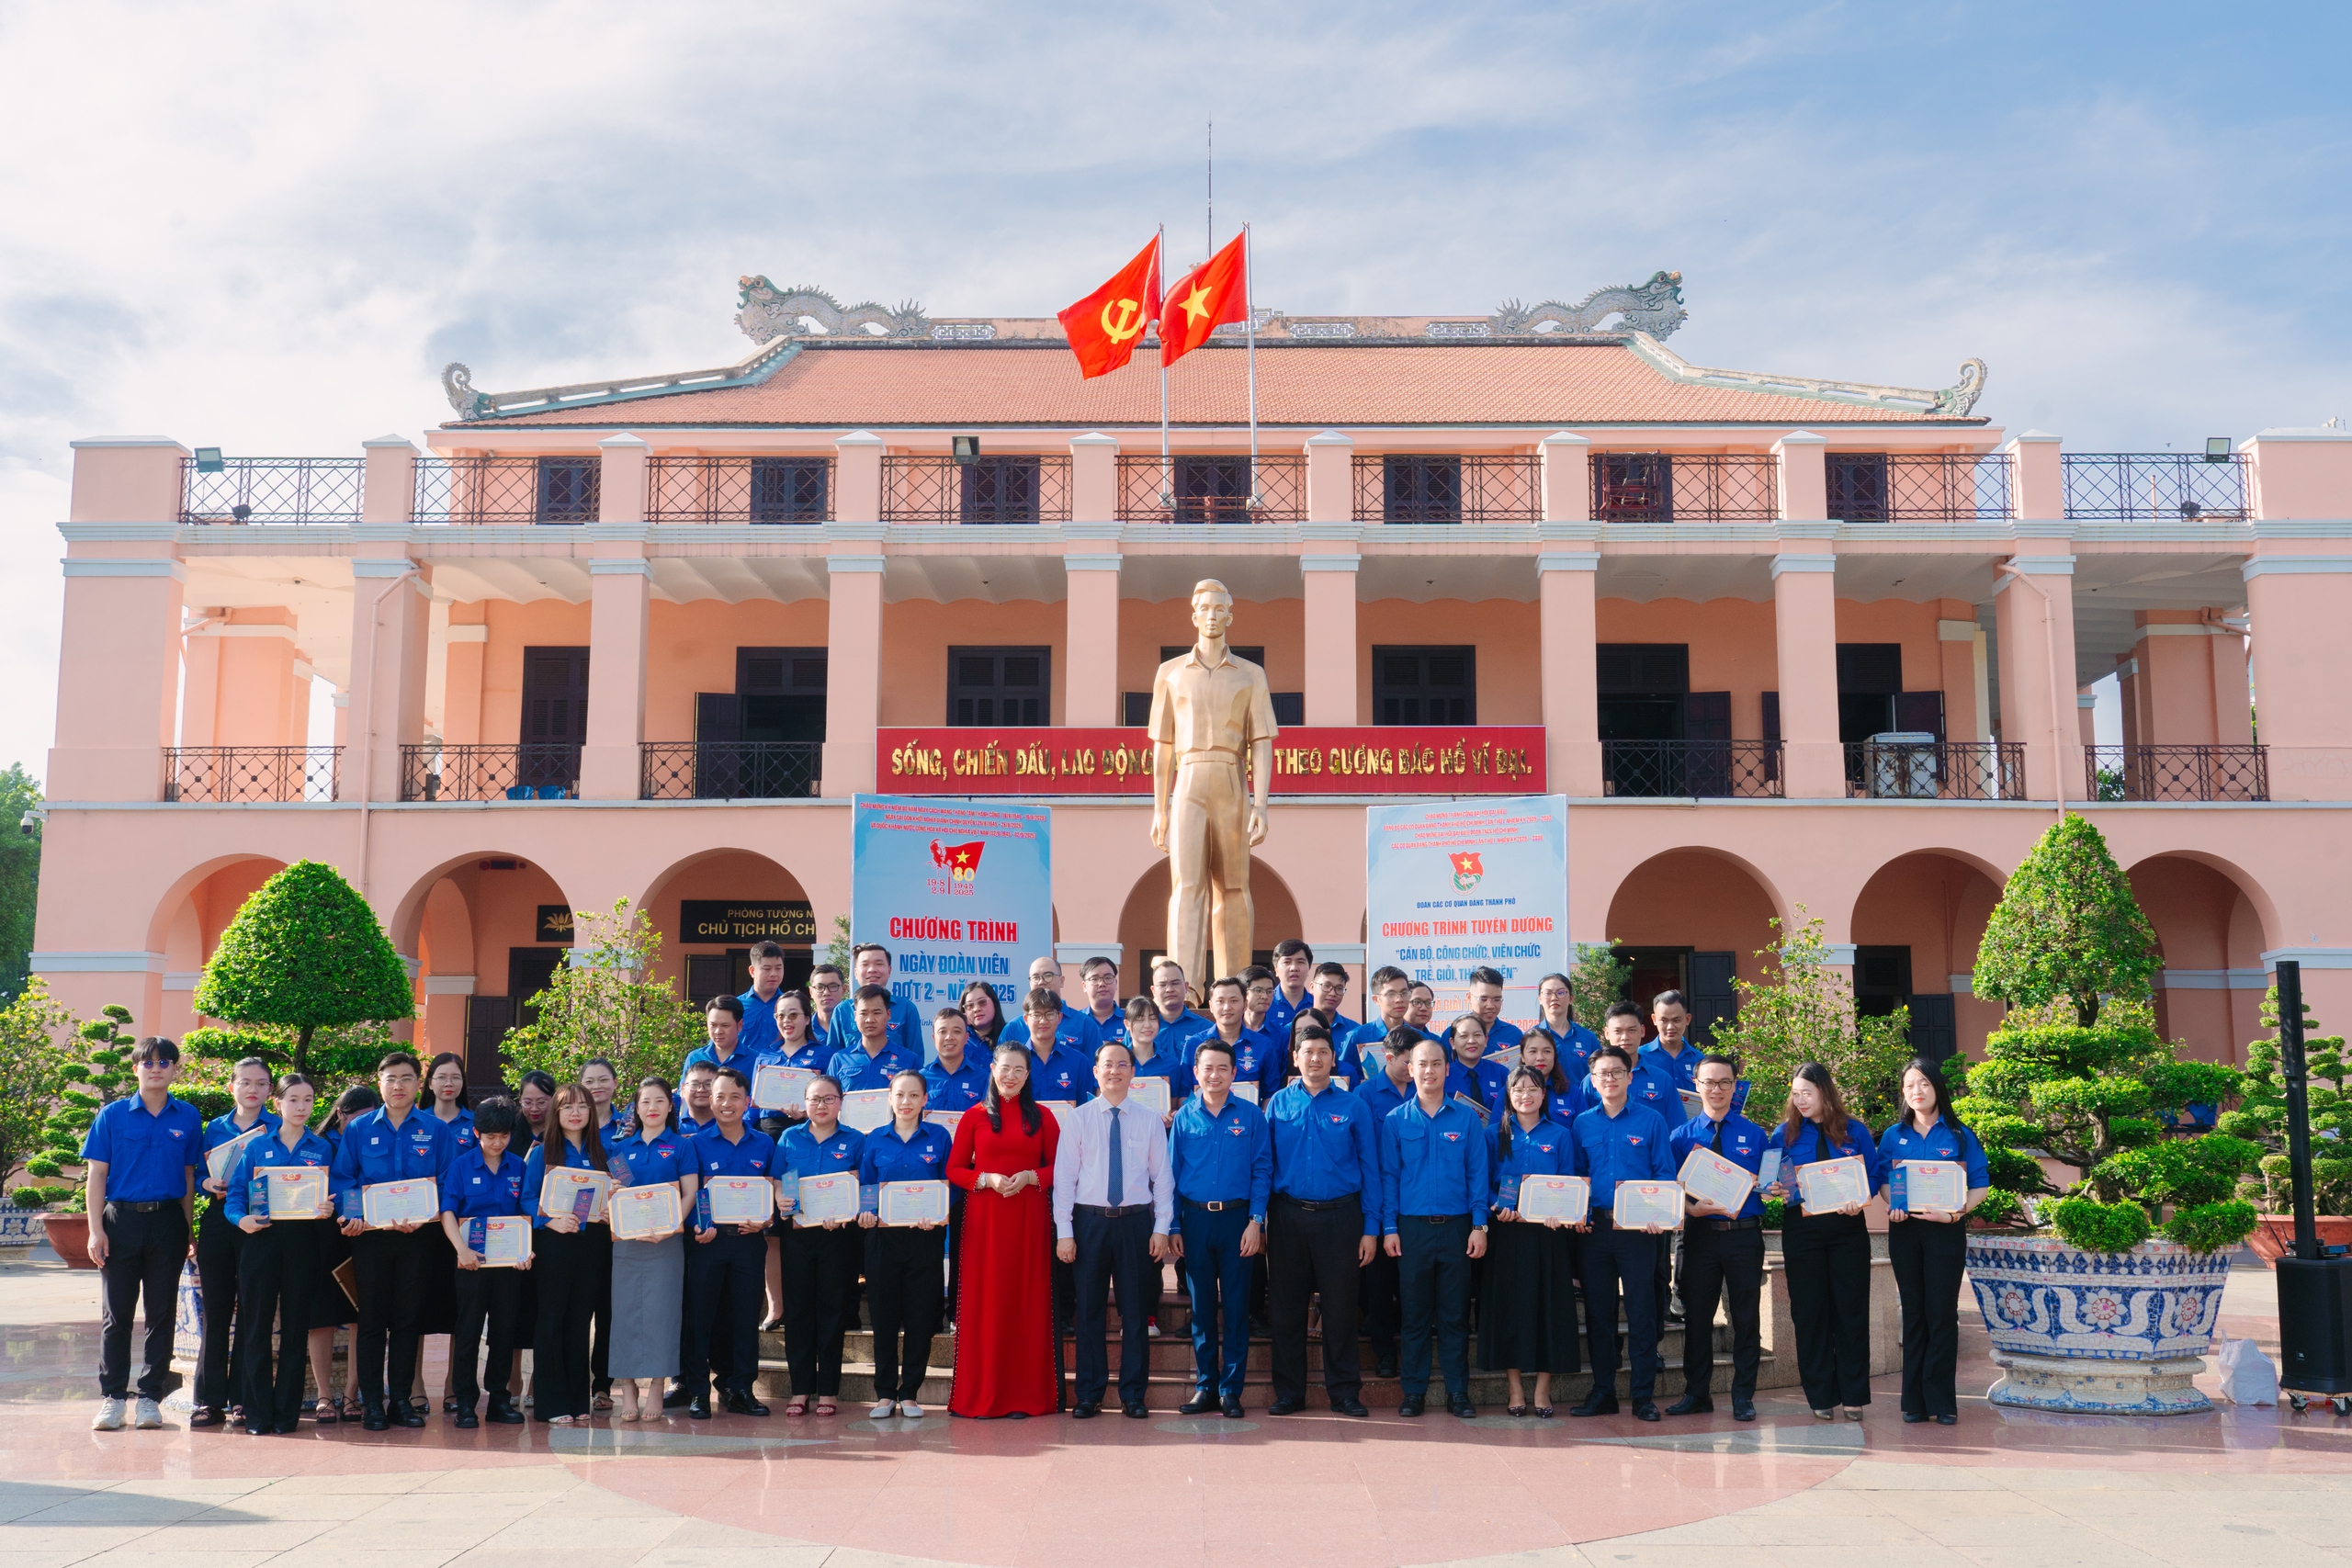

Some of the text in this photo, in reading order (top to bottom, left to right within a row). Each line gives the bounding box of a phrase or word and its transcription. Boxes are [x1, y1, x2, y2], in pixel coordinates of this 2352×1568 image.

[891, 739, 947, 782] SỐNG,
[954, 740, 1009, 775] CHIẾN
[1015, 740, 1057, 781] ĐẤU,
[1061, 749, 1096, 775] LAO
[1102, 742, 1153, 783] ĐỘNG
[1274, 748, 1323, 775] THEO
[1329, 743, 1393, 775] GƯƠNG
[1399, 742, 1435, 775] BÁC
[1441, 738, 1467, 775] HỒ
[1471, 741, 1491, 775] VĨ
[1496, 748, 1532, 782] ĐẠI.
[927, 879, 945, 887] 19-8
[953, 867, 975, 882] 80
[931, 886, 945, 895] 2-9
[1417, 896, 1516, 909] ĐOÀN CÁC CƠ QUAN ĐẢNG THÀNH PHỐ
[728, 907, 763, 919] PHÒNG
[697, 919, 815, 938] CHỦ TỊCH HỒ CH
[889, 916, 1019, 943] CHƯƠNG TRÌNH
[1382, 915, 1554, 938] CHƯƠNG TRÌNH TUYÊN DƯƠNG
[1419, 945, 1435, 964] BỘ,
[1436, 945, 1461, 960] CÔNG
[1462, 943, 1490, 961] CHỨC,
[1491, 943, 1512, 958] VIÊN
[1515, 942, 1541, 958] CHỨC
[899, 951, 1011, 976] NGÀY ĐOÀN VIÊN
[1415, 965, 1436, 982] TRẺ,
[1437, 964, 1457, 982] GIỎI,
[924, 982, 934, 1002] 2
[947, 978, 967, 1002] NĂ
[991, 984, 1016, 1003] 025
[1443, 994, 1463, 1012] GIẢI
